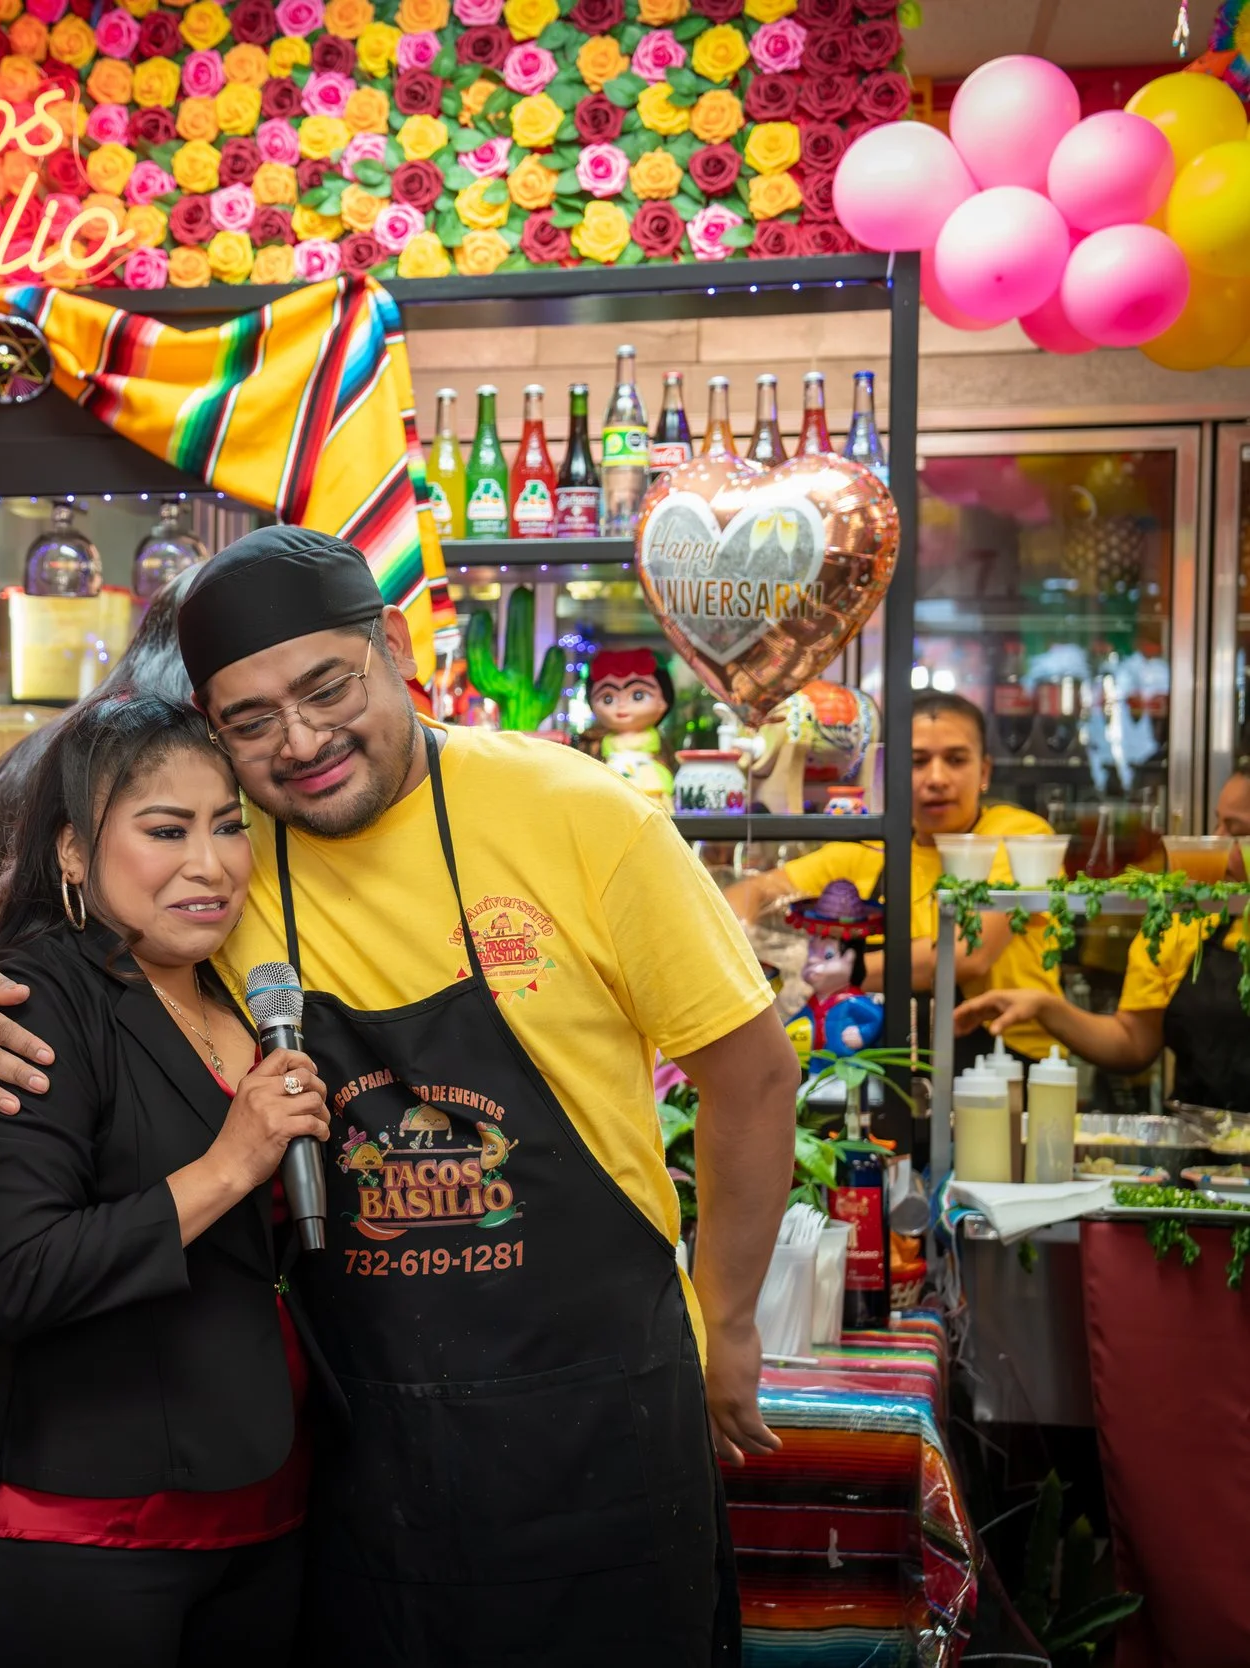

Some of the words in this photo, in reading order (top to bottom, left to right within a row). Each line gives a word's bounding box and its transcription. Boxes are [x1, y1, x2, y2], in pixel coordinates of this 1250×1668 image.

[648, 516, 720, 575] Happy
[465, 896, 554, 937] Aniversario
[477, 947, 537, 963] BASILIO
[485, 938, 525, 952] TACOS
[358, 1068, 394, 1092] PARA
[431, 1085, 447, 1102] DE
[448, 1086, 506, 1121] EVENTOS
[381, 1158, 482, 1189] TACOS
[358, 1179, 514, 1218] BASILIO
[344, 1240, 524, 1277] 732-619-1281
